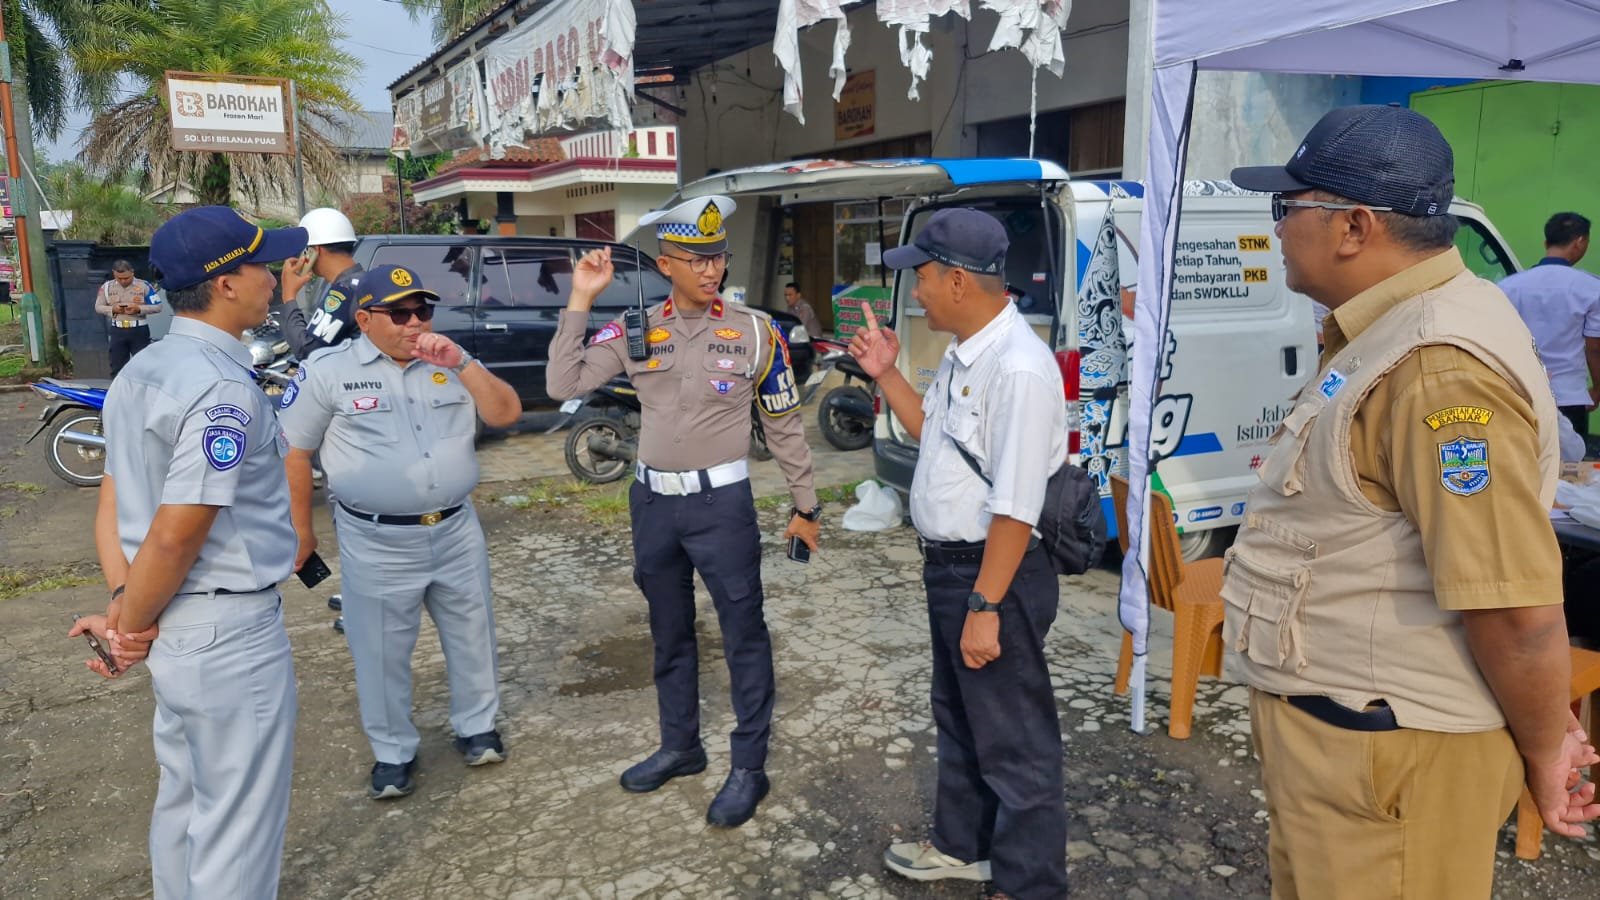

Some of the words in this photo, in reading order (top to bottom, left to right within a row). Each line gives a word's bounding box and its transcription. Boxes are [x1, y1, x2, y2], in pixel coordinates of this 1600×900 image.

[206, 94, 278, 112] BAROKAH
[184, 134, 215, 143] SOLUSI
[216, 136, 254, 144] BELANJA
[254, 137, 277, 145] PUAS
[1176, 239, 1236, 252] engesahan
[1239, 238, 1270, 250] STNK
[1175, 255, 1203, 268] etiap
[1205, 254, 1242, 268] Tahun,
[1172, 271, 1241, 285] Pembayaran
[1243, 270, 1268, 282] PKB
[1171, 289, 1192, 301] dan
[1193, 286, 1249, 300] SWDKLLJ
[305, 307, 345, 345] PM
[648, 344, 675, 356] DHO
[708, 344, 747, 354] POLRI
[343, 382, 383, 394] WAHYU
[1440, 413, 1482, 424] BANJAR
[1472, 409, 1492, 418] KOTA
[1236, 424, 1279, 442] Istim
